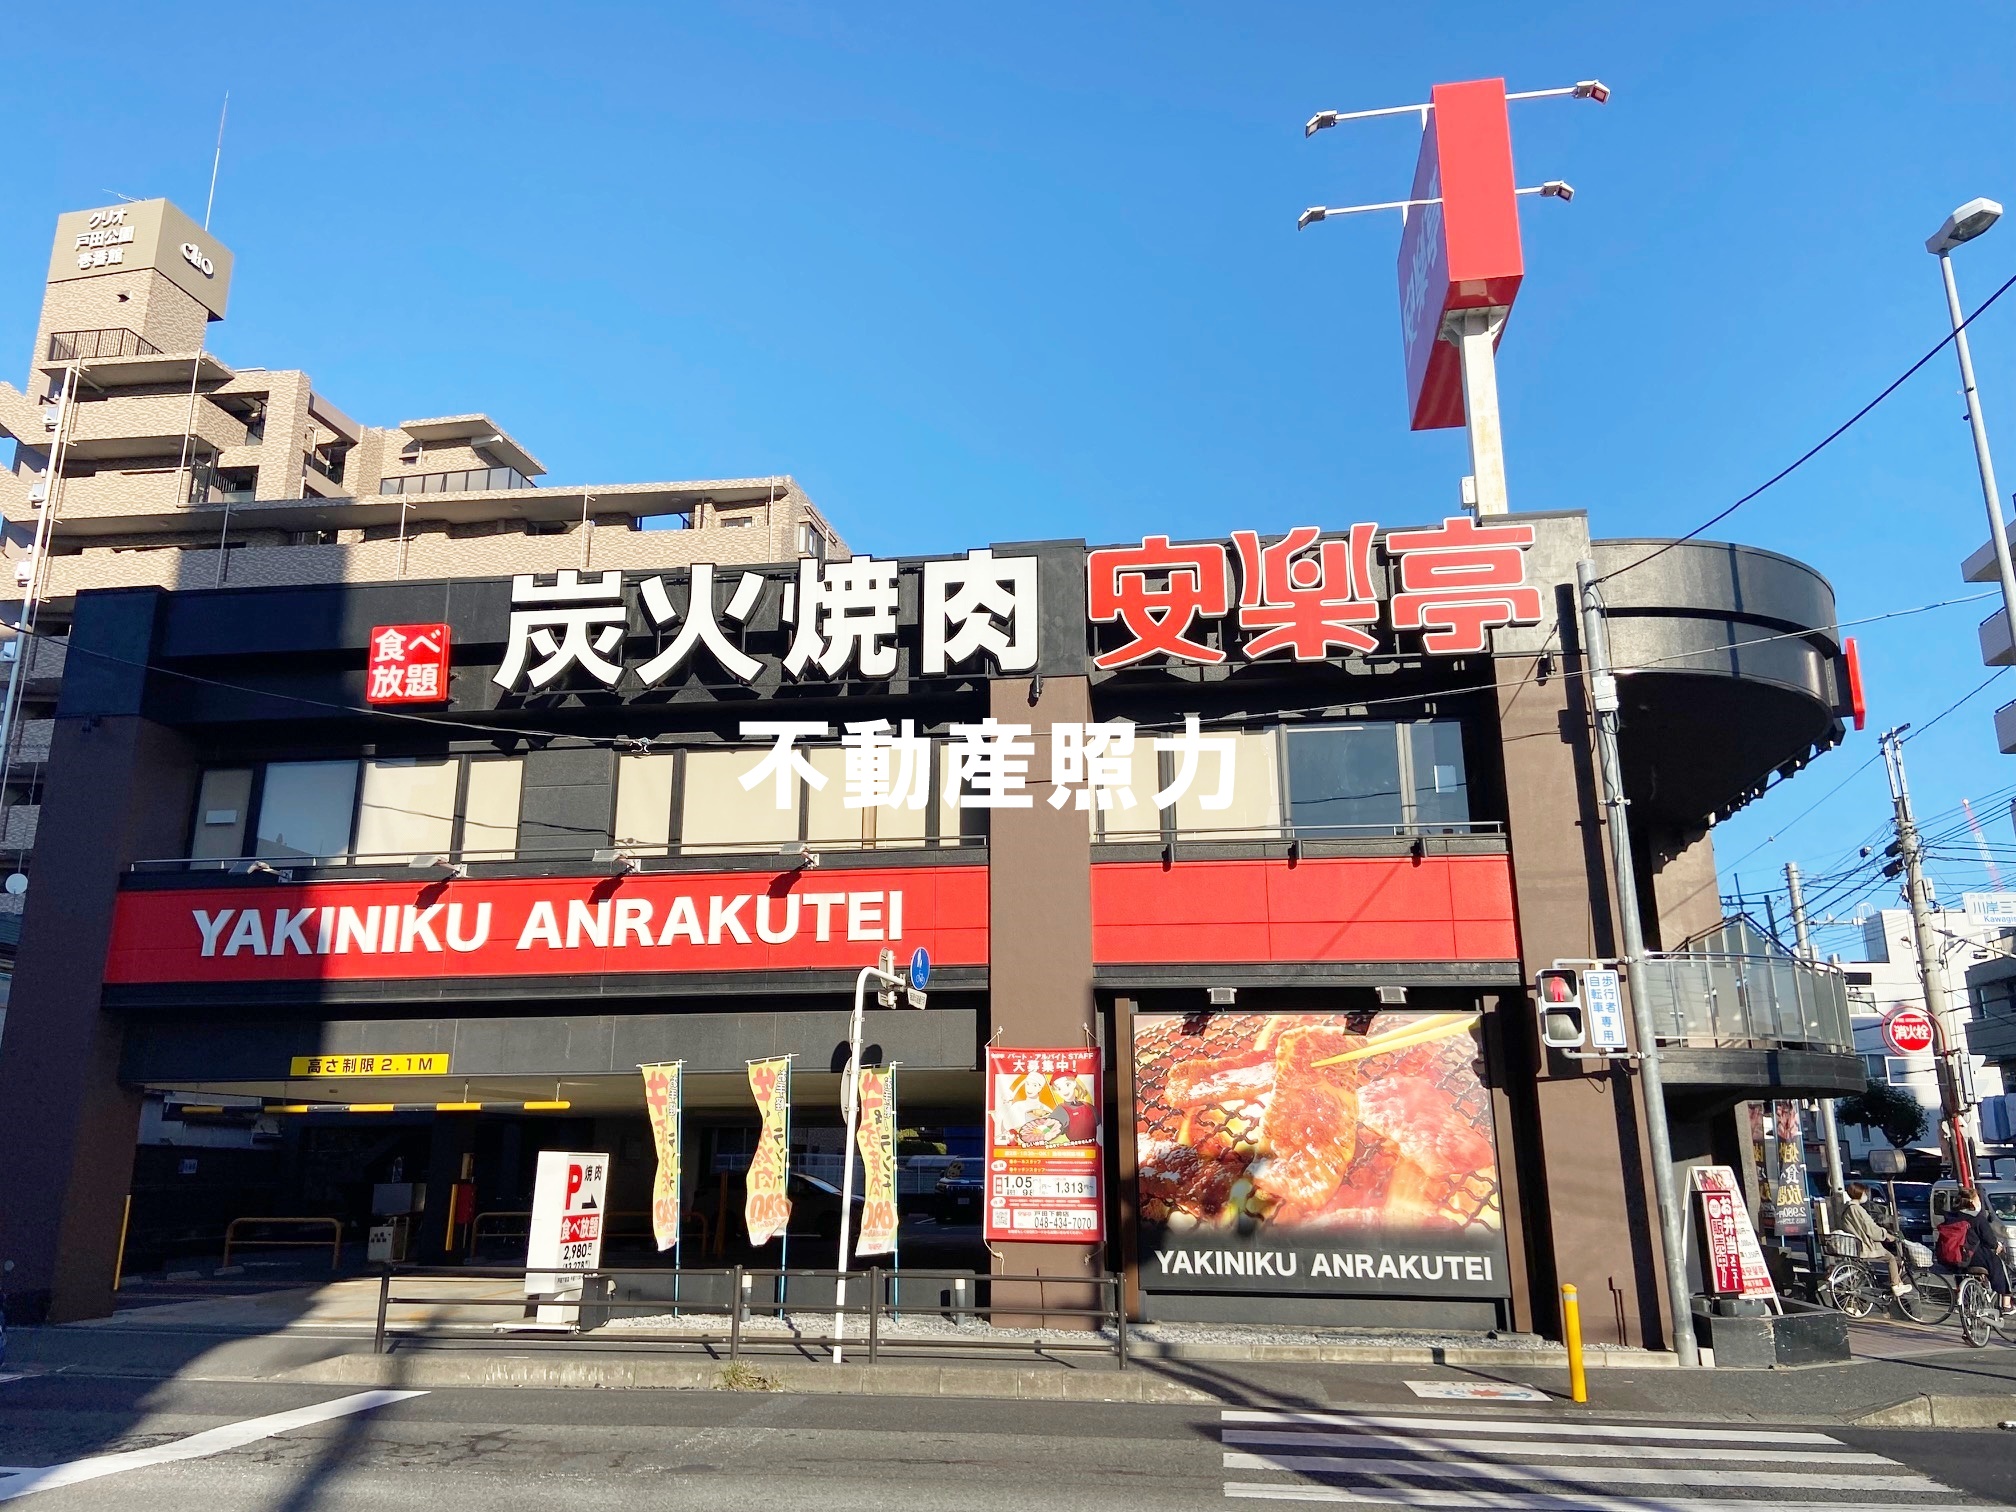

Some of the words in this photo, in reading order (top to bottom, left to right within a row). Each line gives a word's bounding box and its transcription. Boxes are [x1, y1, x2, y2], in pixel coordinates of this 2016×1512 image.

[88, 208, 128, 229] クリオ
[74, 225, 136, 251] 戸田公園
[77, 247, 125, 270] 壱番館
[491, 548, 1041, 690] 炭火焼肉
[1087, 516, 1544, 670] 安楽亭
[374, 628, 441, 662] 食べ
[371, 663, 439, 698] 放題
[1973, 900, 2016, 914] 川岸三
[192, 902, 492, 957] YAKINIKU
[516, 890, 902, 950] ANRAKUTEI
[1588, 976, 1604, 1013] 自転車
[1601, 975, 1617, 1013] 歩行者
[1601, 1016, 1615, 1041] 専用
[1894, 1024, 1930, 1040] 消火栓
[565, 1164, 583, 1210] P
[583, 1165, 603, 1182] 焼肉
[560, 1216, 600, 1240] 食べ放題
[1154, 1250, 1297, 1277] YAKINIKU
[1310, 1253, 1493, 1281] ANRAKUTEI
